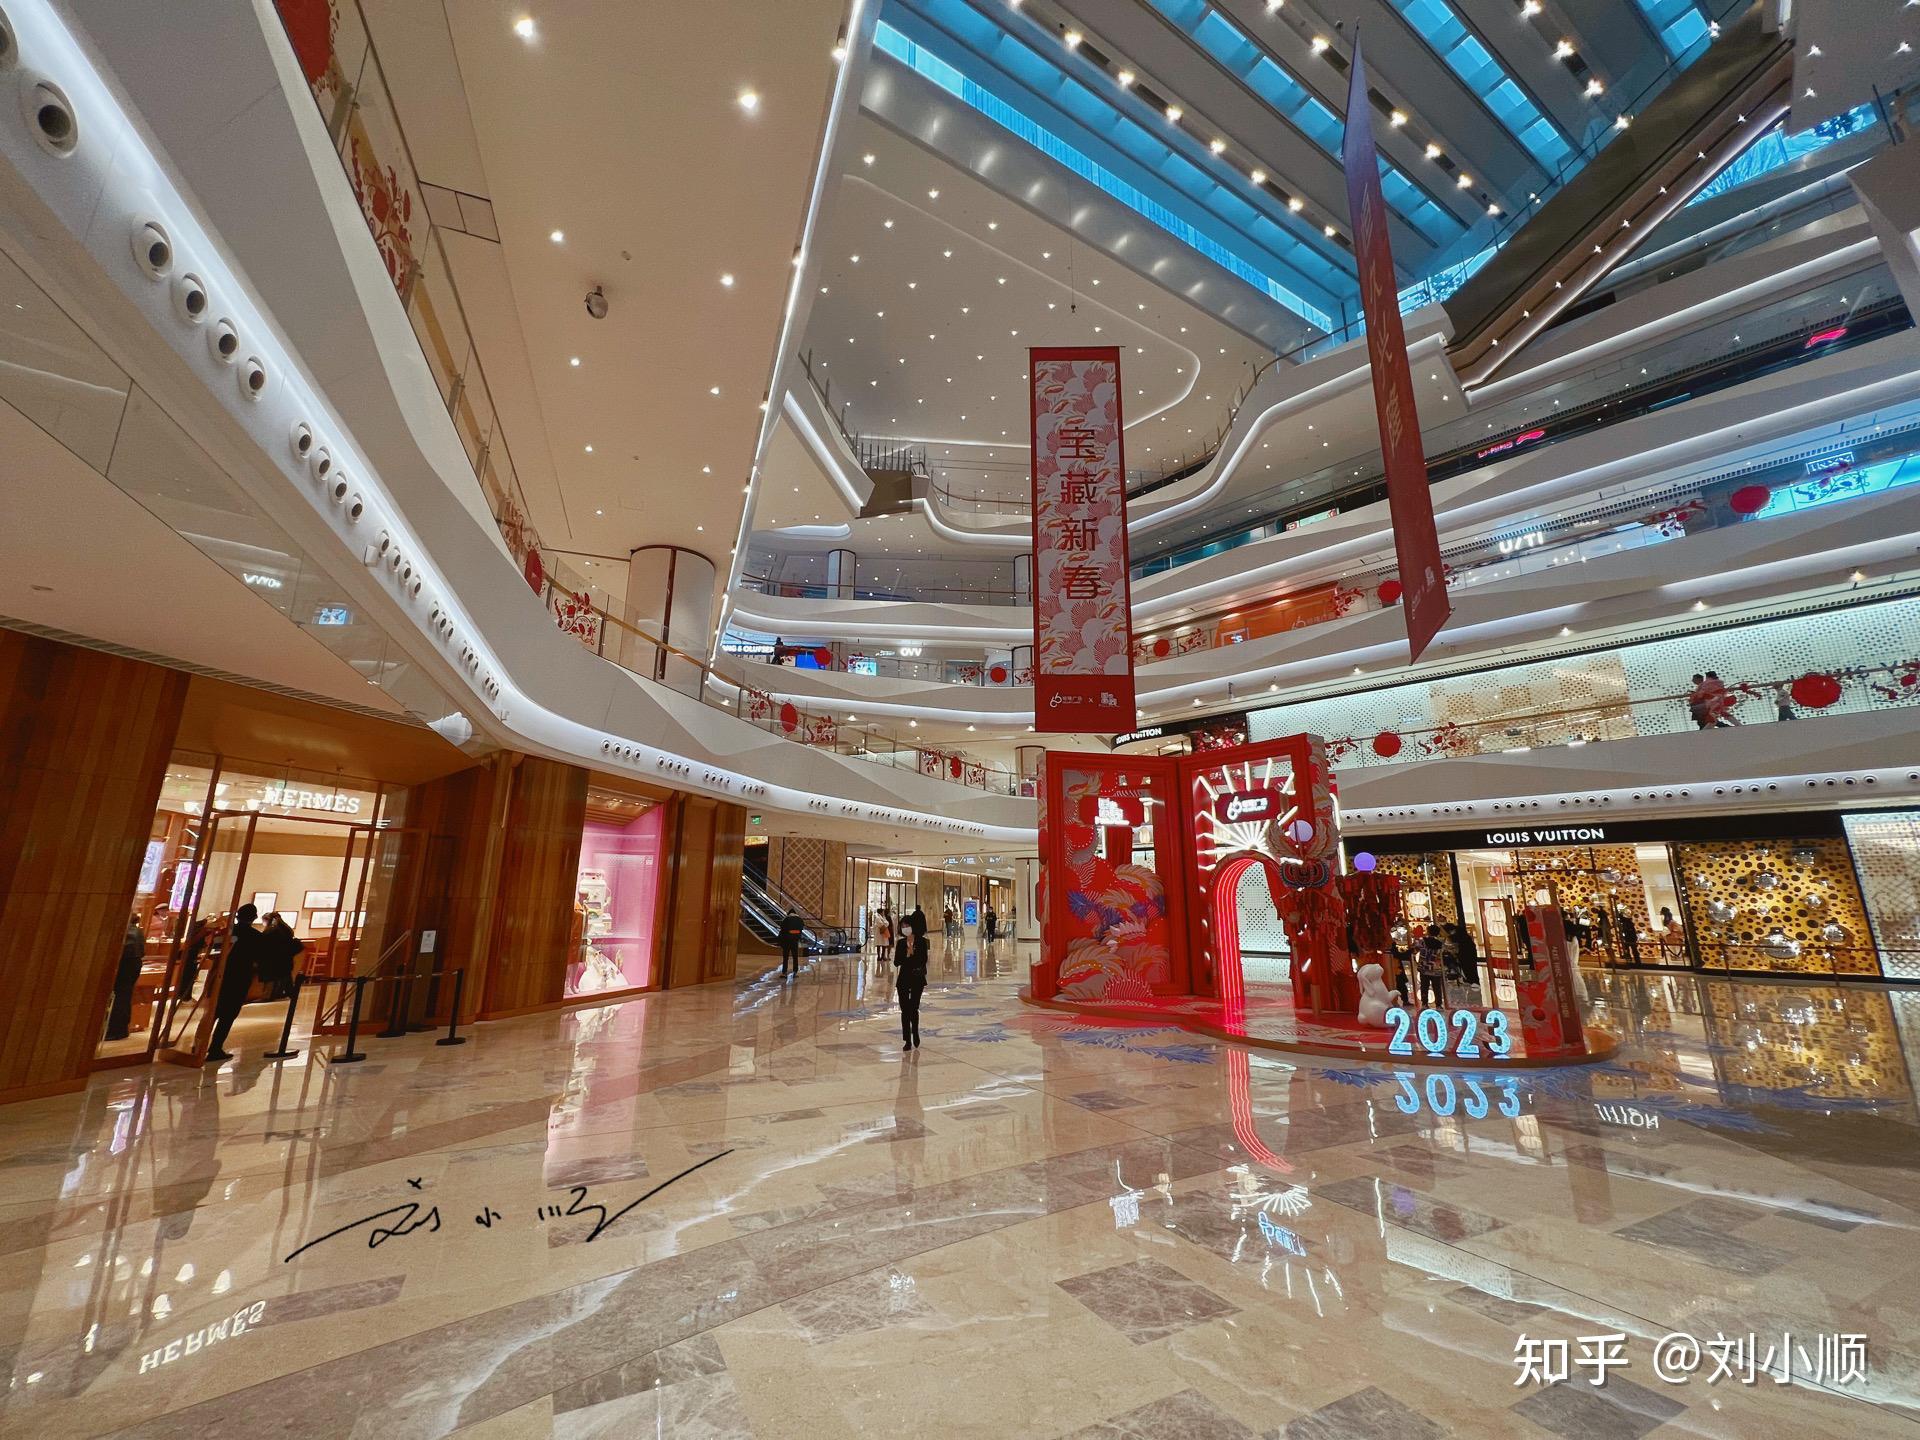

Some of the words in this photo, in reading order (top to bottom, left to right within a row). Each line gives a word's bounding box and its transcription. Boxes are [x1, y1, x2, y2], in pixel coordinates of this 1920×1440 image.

[1059, 426, 1101, 600] 宝藏新春
[1131, 728, 1162, 739] VUITTON
[1487, 832, 1530, 844] LOUIS
[1534, 828, 1605, 842] VUITTON
[1385, 1007, 1511, 1054] 2023
